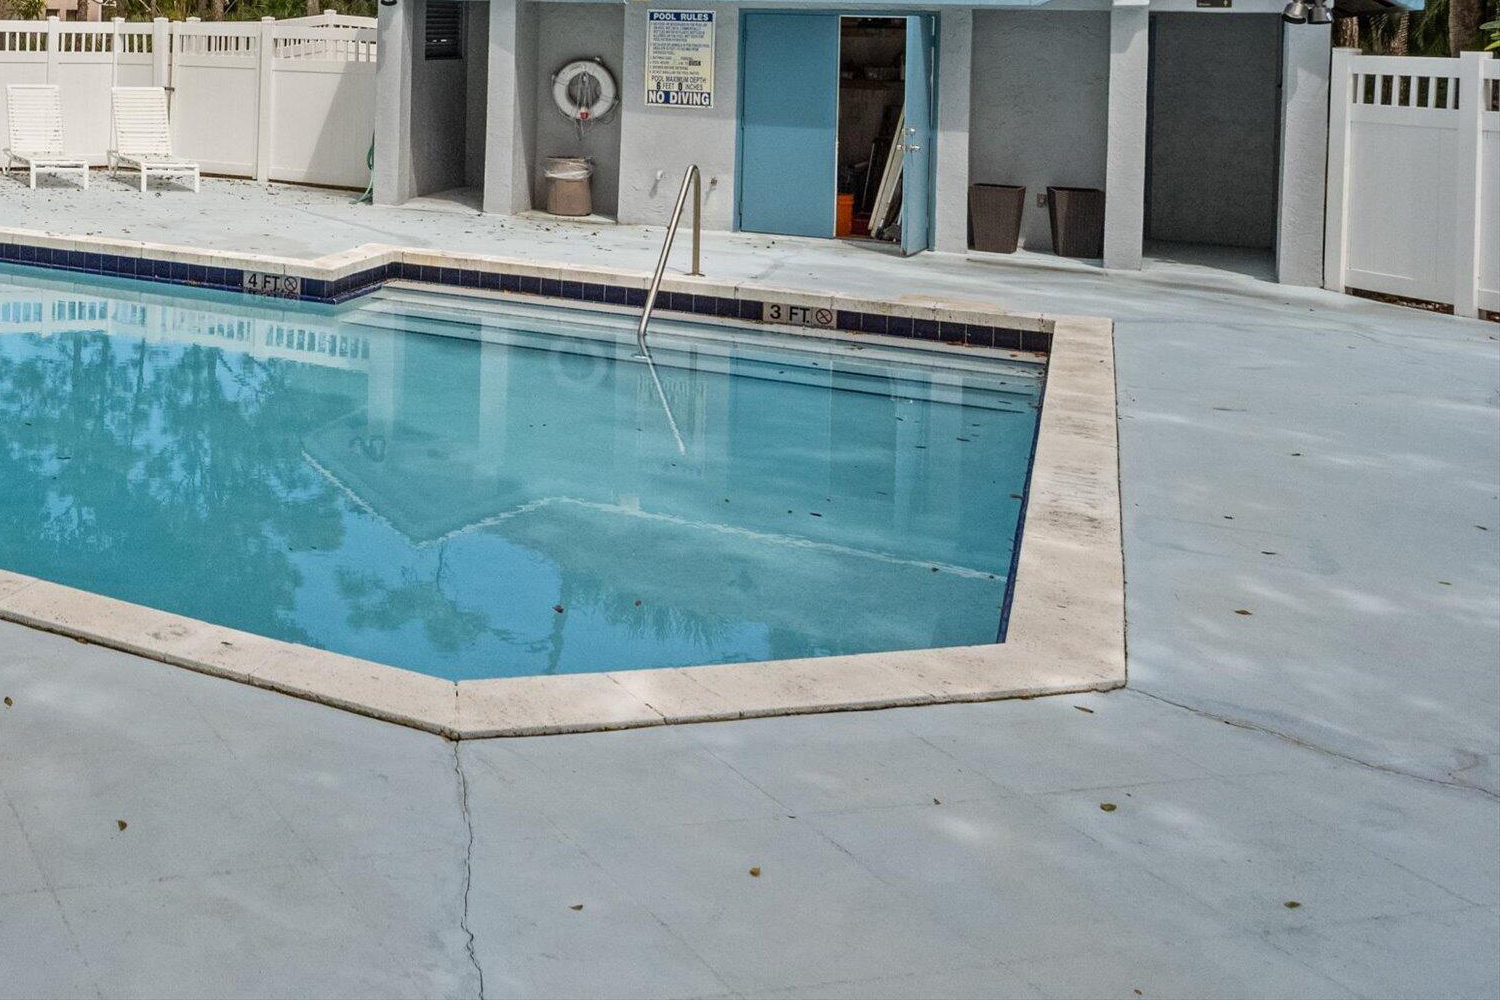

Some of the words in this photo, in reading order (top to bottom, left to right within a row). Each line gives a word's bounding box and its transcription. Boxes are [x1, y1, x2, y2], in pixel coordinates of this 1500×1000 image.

[649, 90, 665, 103] NO
[669, 91, 710, 105] DIVING
[248, 274, 257, 287] 4
[770, 305, 780, 319] 3
